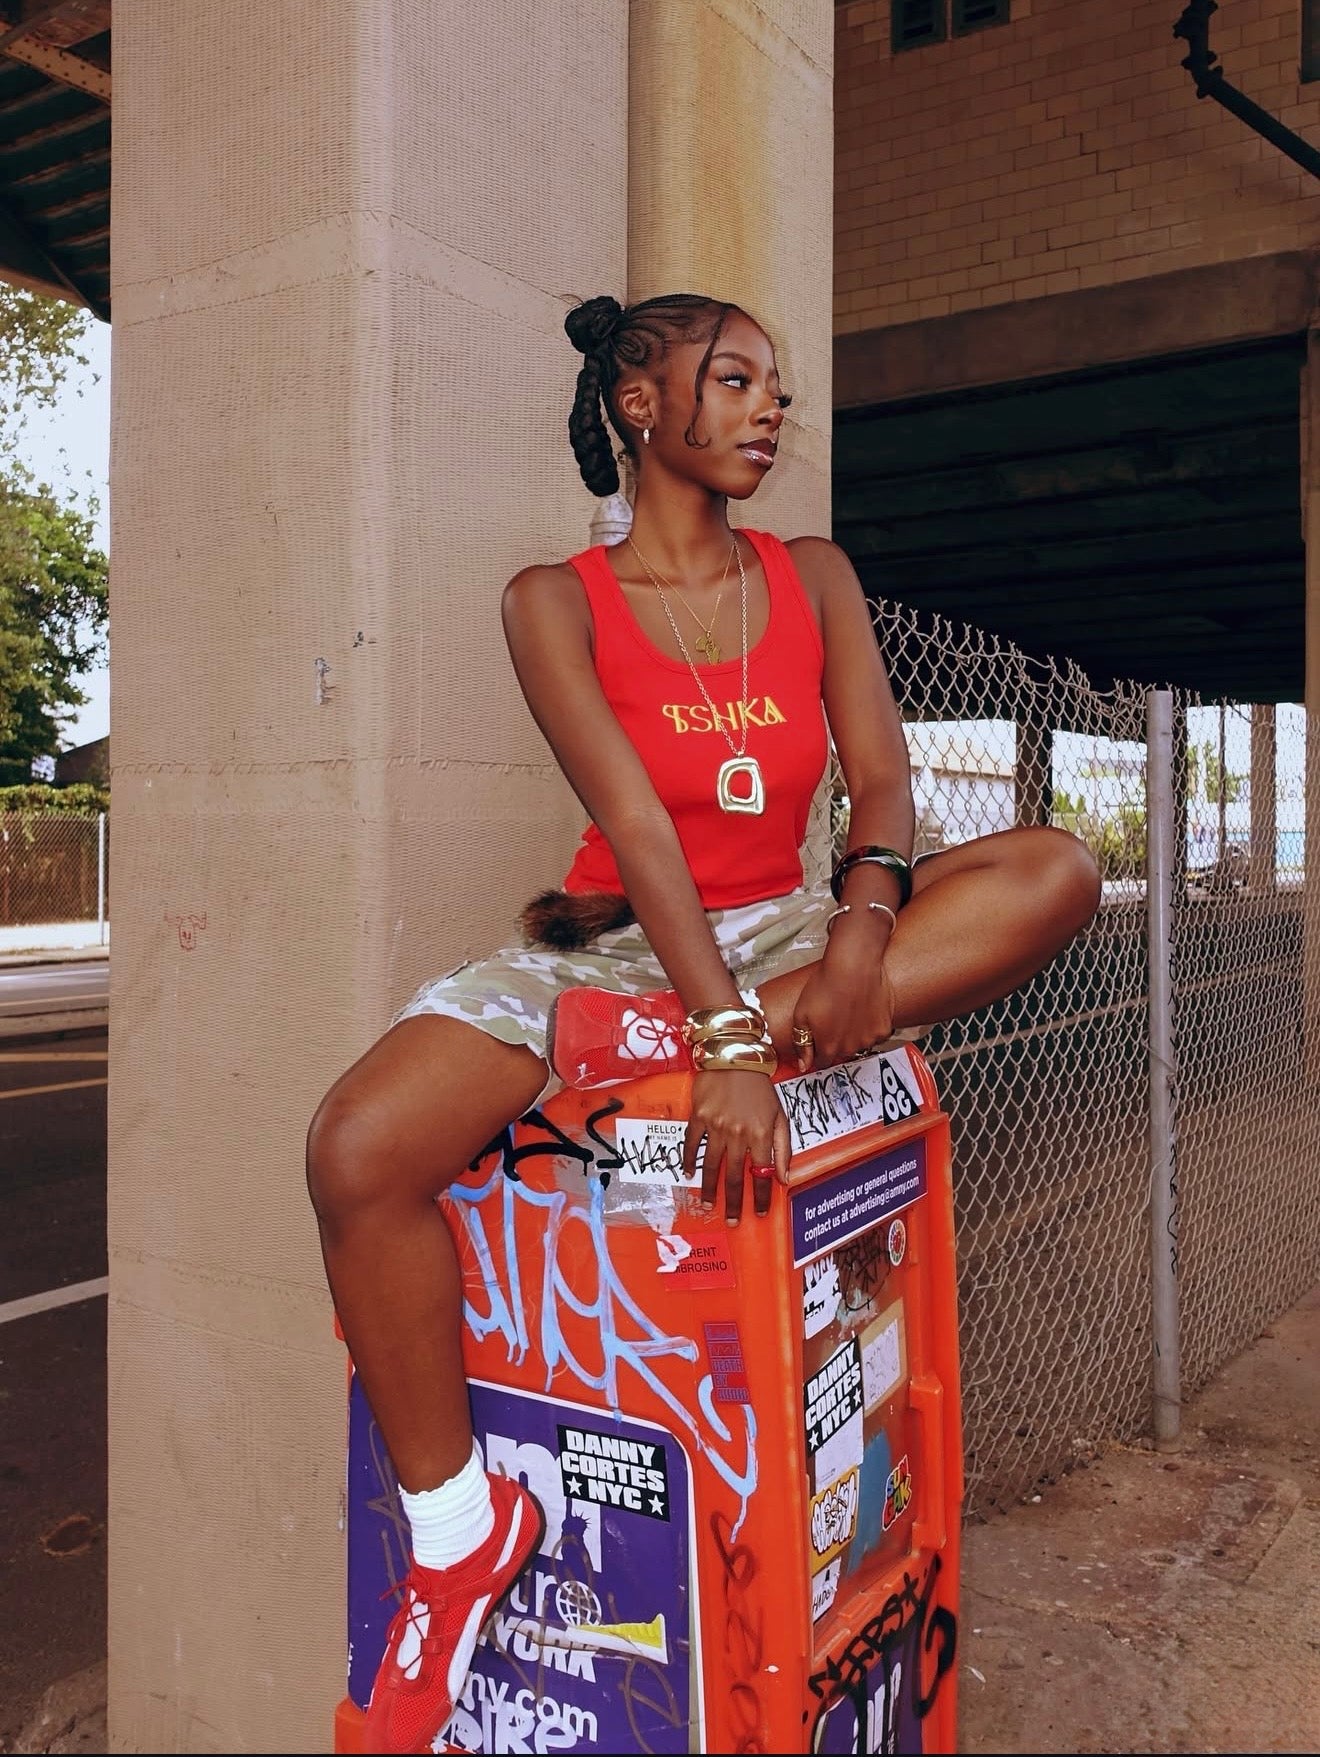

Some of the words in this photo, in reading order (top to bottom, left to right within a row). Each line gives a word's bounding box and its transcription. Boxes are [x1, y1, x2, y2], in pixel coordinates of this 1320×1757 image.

[647, 1125, 677, 1134] HELLO
[805, 1207, 816, 1221] for
[817, 1189, 855, 1216] advertising
[855, 1184, 863, 1196] or
[864, 1170, 888, 1194] general
[888, 1159, 917, 1182] questions
[804, 1218, 831, 1242] contact
[832, 1215, 840, 1228] us
[841, 1209, 849, 1223] at
[807, 1341, 855, 1405] DANNY
[805, 1361, 861, 1431] CORTES
[820, 1395, 851, 1441] NYC
[566, 1429, 655, 1466] DANNY
[561, 1451, 665, 1492] CORTES
[588, 1478, 642, 1510] NYC
[466, 1672, 598, 1743] ny.com
